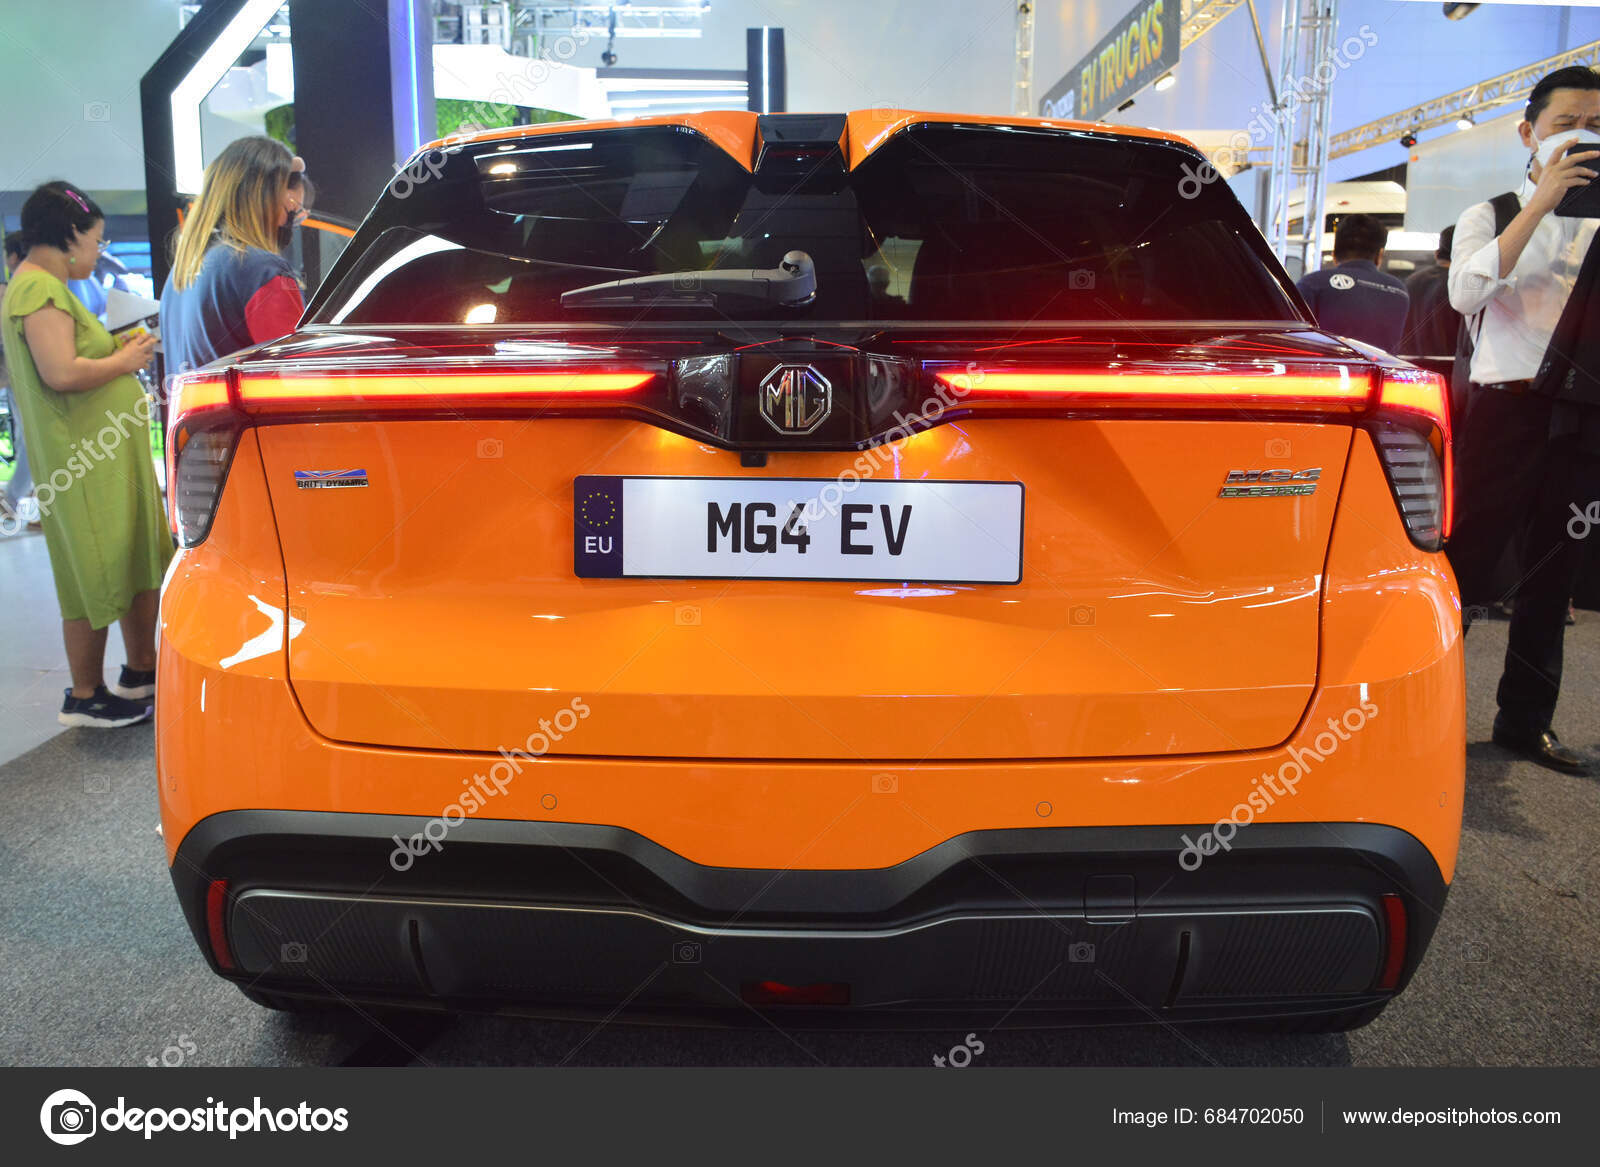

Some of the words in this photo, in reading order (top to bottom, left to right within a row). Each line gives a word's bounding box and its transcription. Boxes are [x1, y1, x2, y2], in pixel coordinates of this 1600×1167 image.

[1081, 58, 1098, 116] EV
[1099, 0, 1163, 102] TRUCKS
[765, 368, 826, 429] MG
[1225, 467, 1322, 483] MG4
[585, 536, 612, 554] EU
[706, 501, 811, 554] MG4
[840, 503, 913, 556] EV
